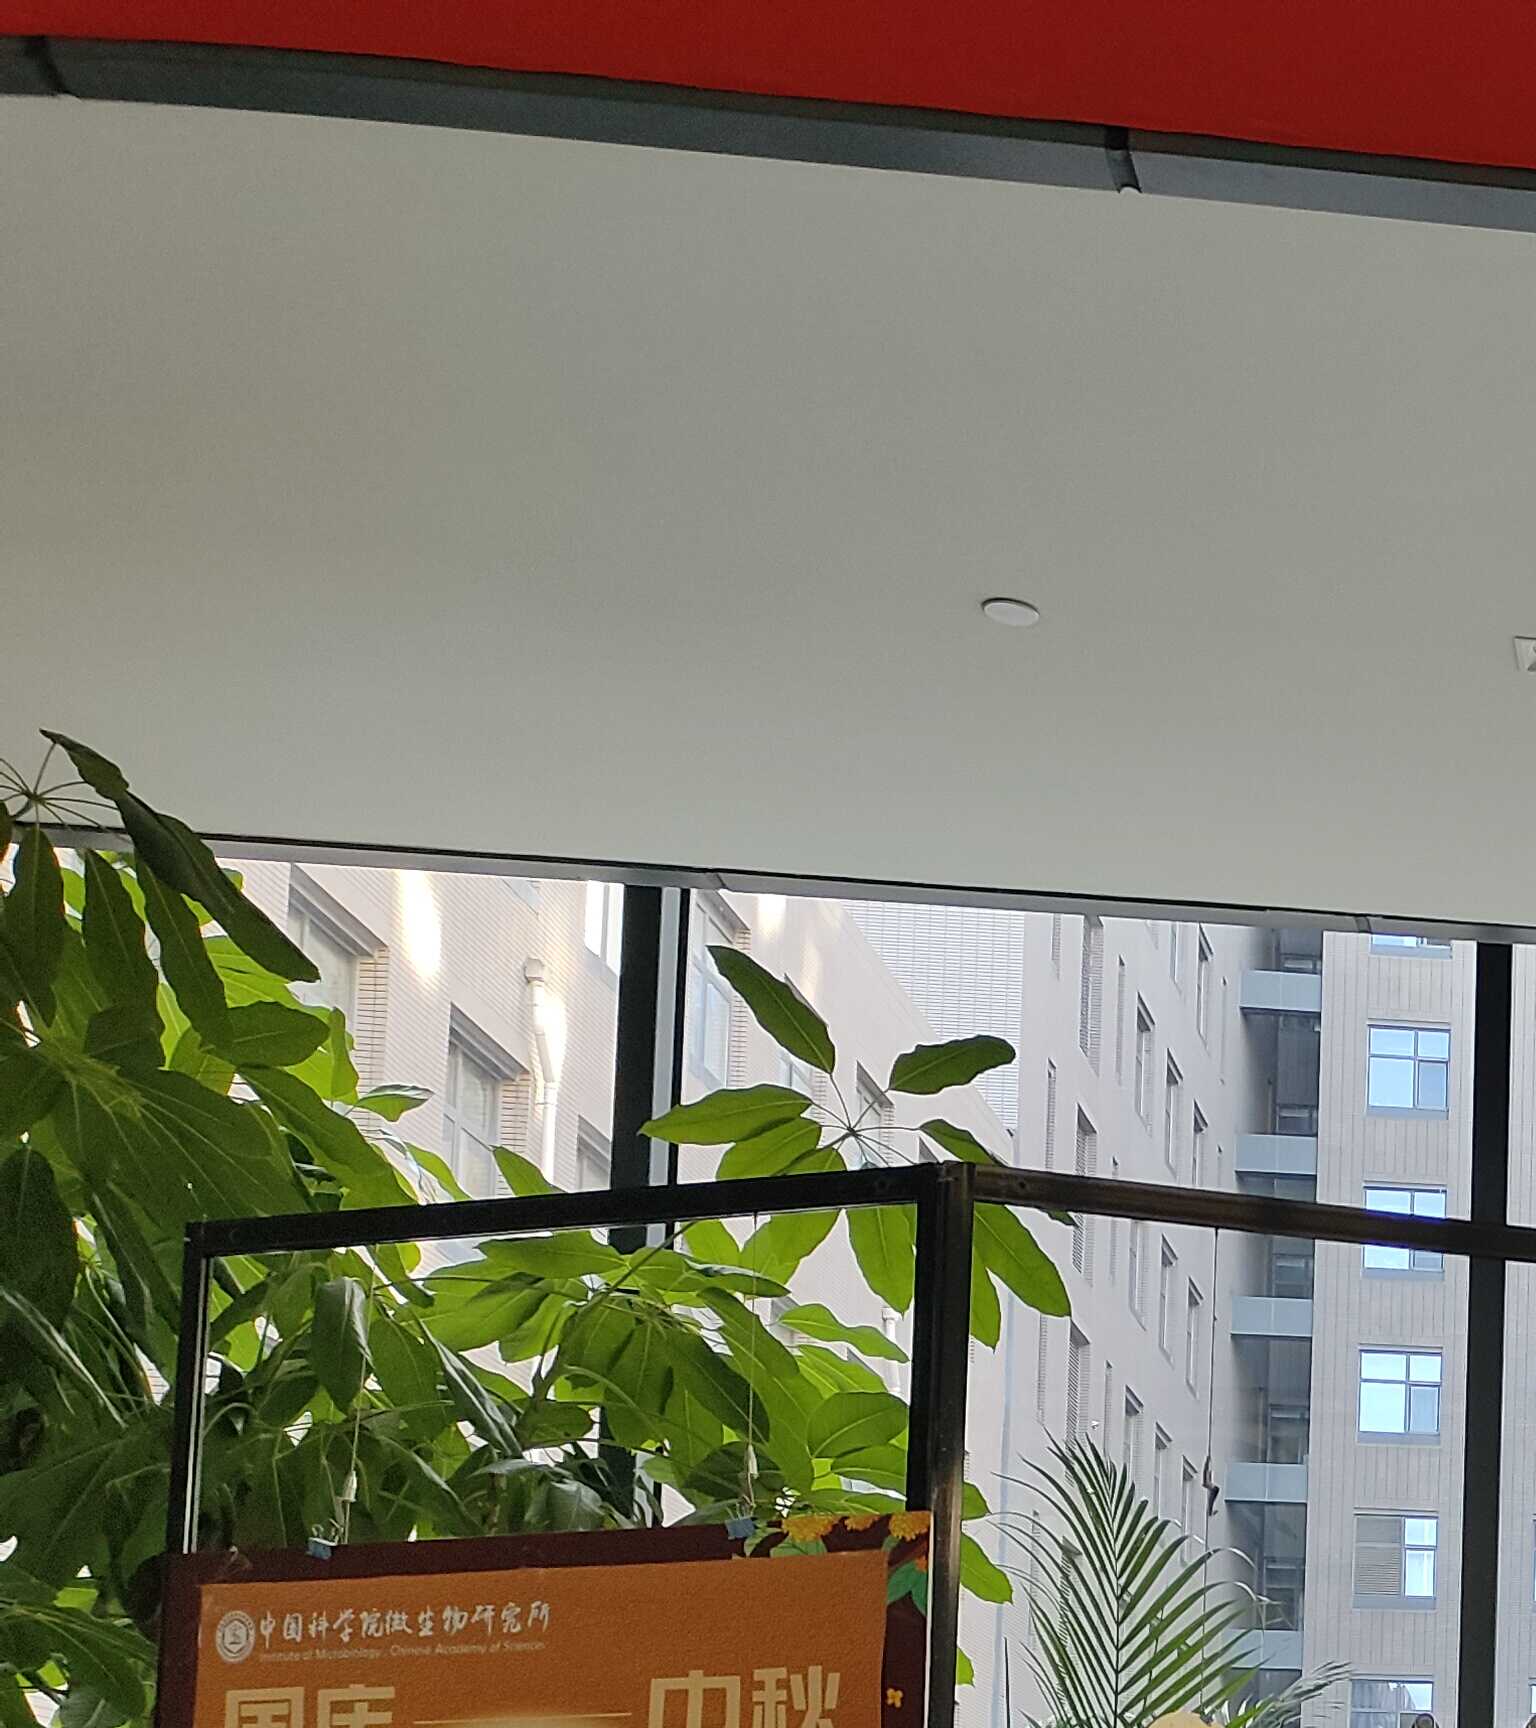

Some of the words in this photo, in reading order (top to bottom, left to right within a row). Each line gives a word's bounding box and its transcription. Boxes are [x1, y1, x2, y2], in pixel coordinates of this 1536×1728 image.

[259, 1601, 551, 1649] 中国科学院微生物研究所
